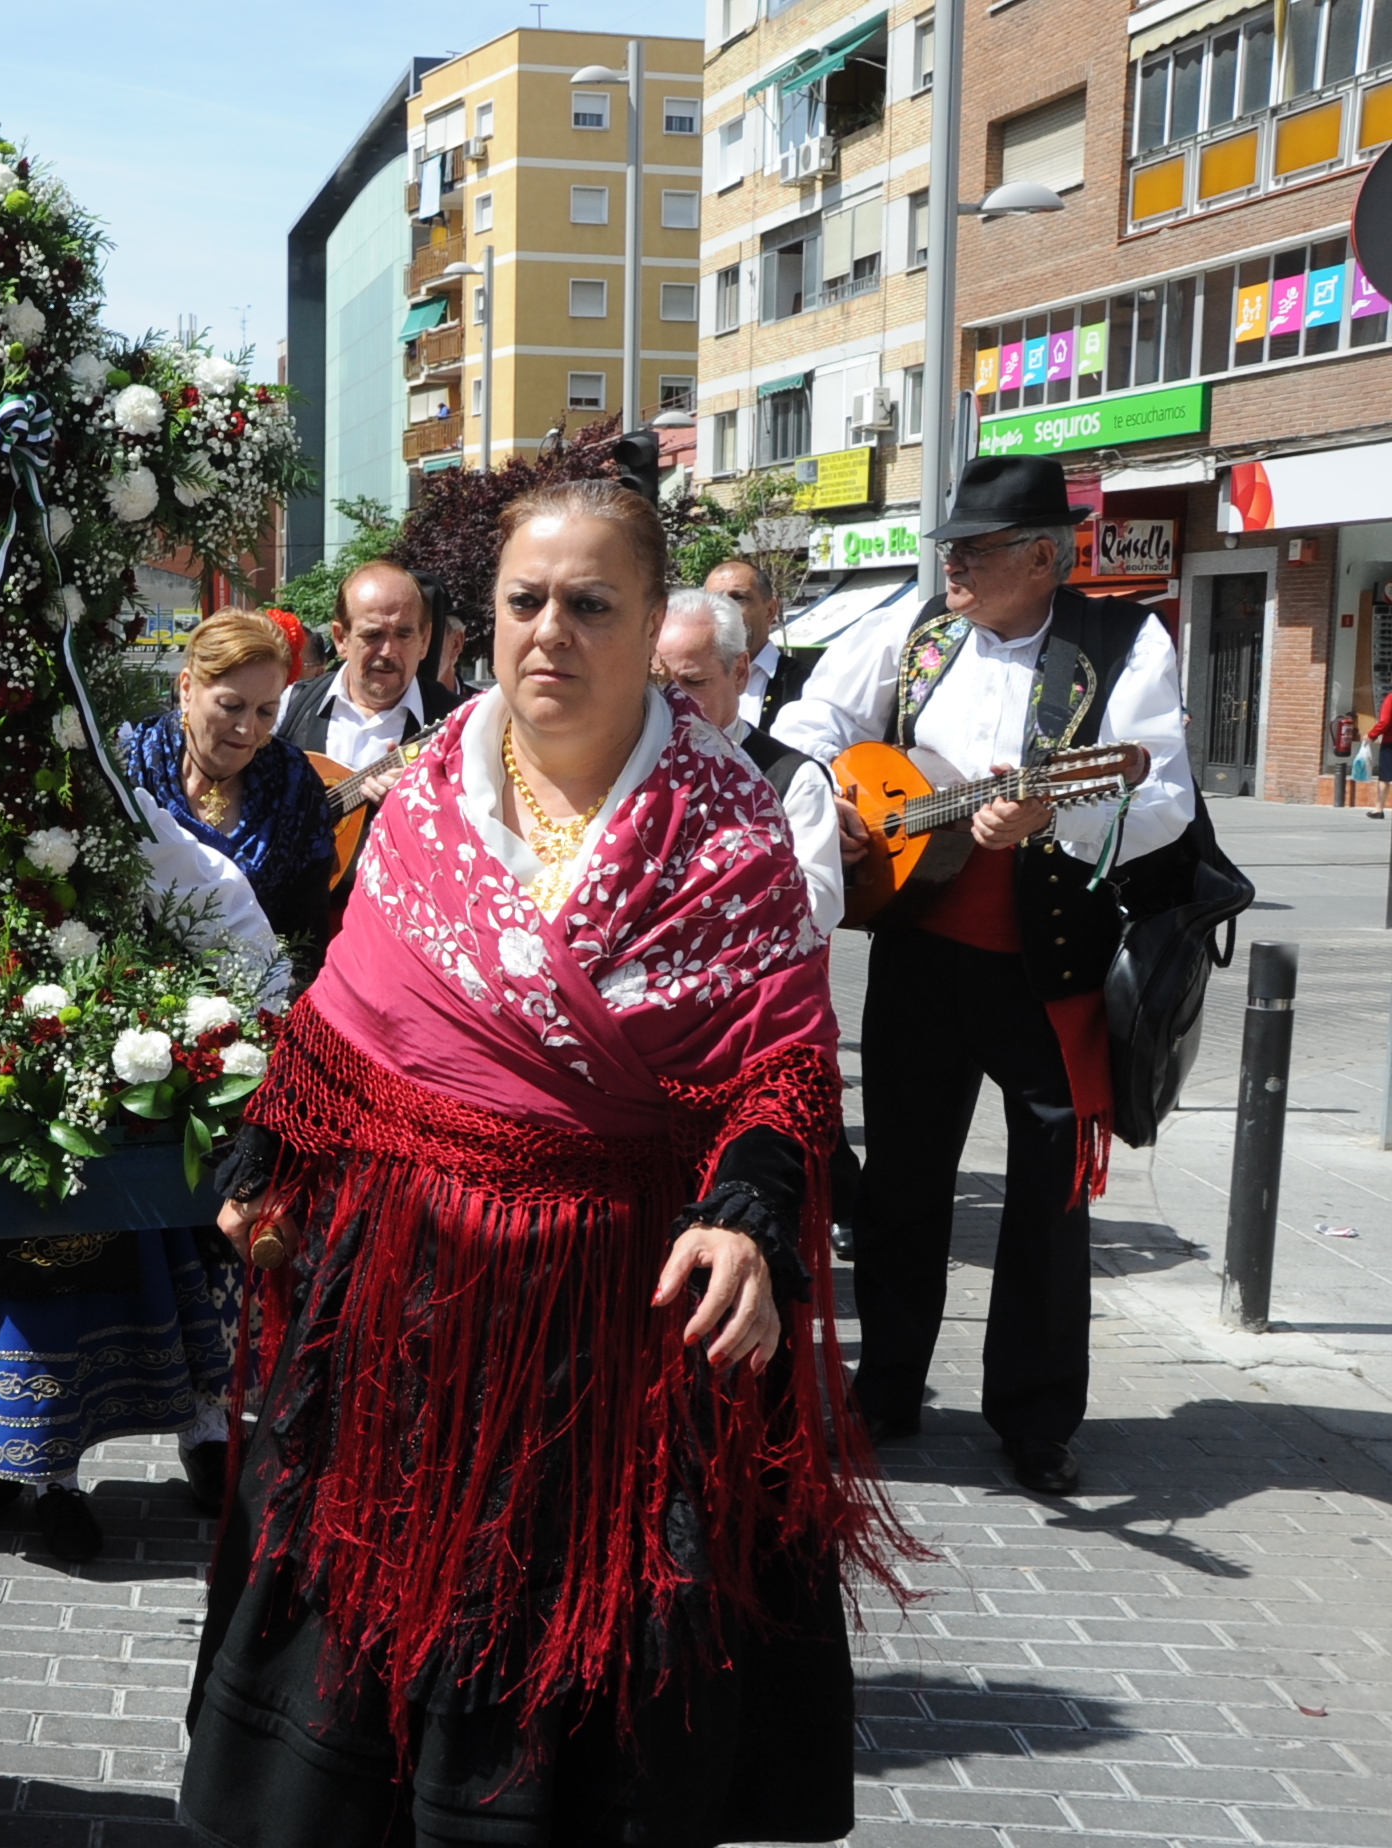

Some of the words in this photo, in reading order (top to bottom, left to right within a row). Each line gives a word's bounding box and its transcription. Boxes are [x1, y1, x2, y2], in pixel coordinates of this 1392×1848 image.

[1034, 411, 1101, 448] seguros
[1114, 414, 1123, 429] te
[1125, 405, 1186, 428] escuchamos
[844, 531, 886, 564] Que
[1101, 524, 1171, 565] Quisella
[1126, 563, 1169, 571] BOUTIQUE
